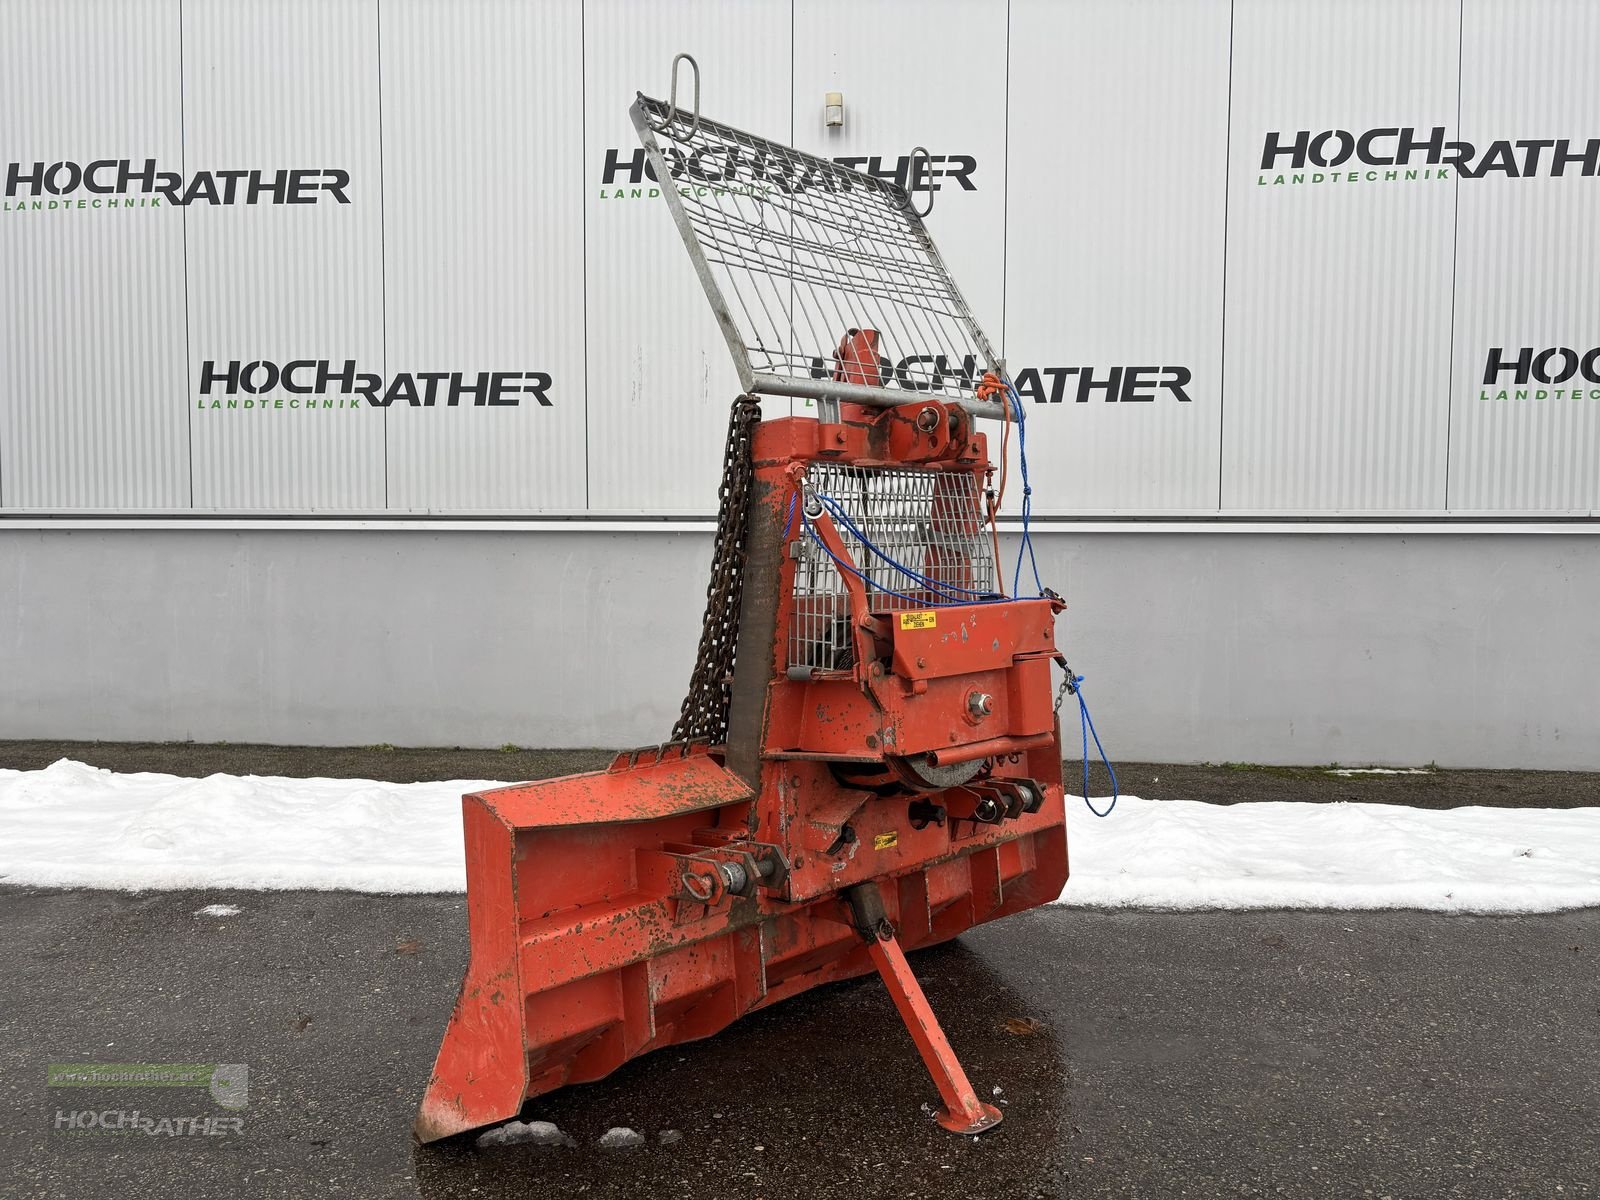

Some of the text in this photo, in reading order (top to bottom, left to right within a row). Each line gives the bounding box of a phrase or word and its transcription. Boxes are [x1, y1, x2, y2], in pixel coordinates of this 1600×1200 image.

[1259, 127, 1600, 179] HOCHRATH
[4, 159, 352, 205] HOCHRATHER
[1257, 168, 1450, 186] LANDTECHNIK
[600, 184, 775, 200] LANDECHNIK
[4, 197, 162, 211] LANDTECHNIK
[199, 360, 553, 407] HOCHRATHER
[197, 399, 361, 409] LANDTECHNIK
